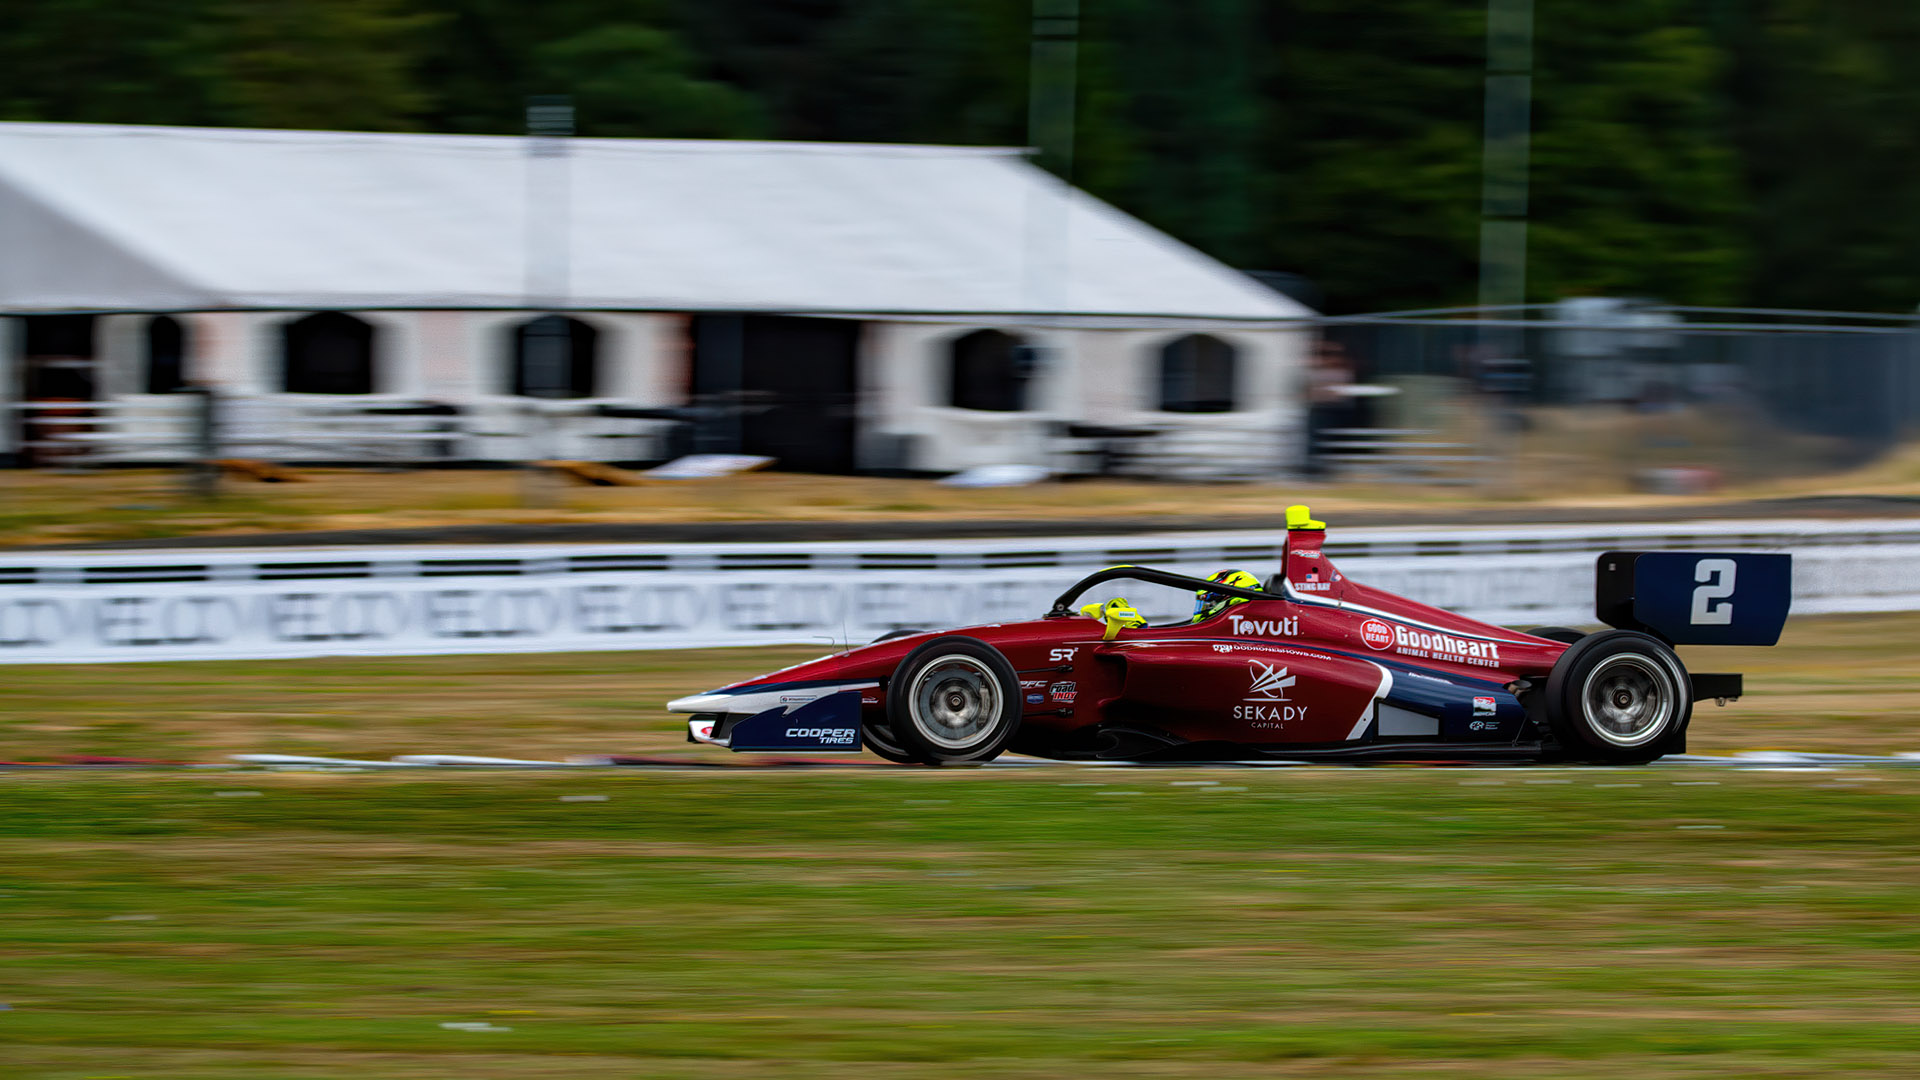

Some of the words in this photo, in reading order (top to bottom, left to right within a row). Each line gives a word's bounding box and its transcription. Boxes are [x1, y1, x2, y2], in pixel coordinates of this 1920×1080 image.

[1690, 558, 1737, 625] 2
[1366, 622, 1388, 634] GOOD
[1365, 632, 1389, 643] HEART
[1395, 625, 1500, 659] Goodheart
[1396, 646, 1429, 658] ANIMAL
[1432, 651, 1464, 663] HEALTH
[1467, 657, 1500, 668] CENTER
[1233, 705, 1308, 721] SEKADY
[1250, 721, 1284, 729] CAPITAL
[785, 728, 855, 738] COOPER
